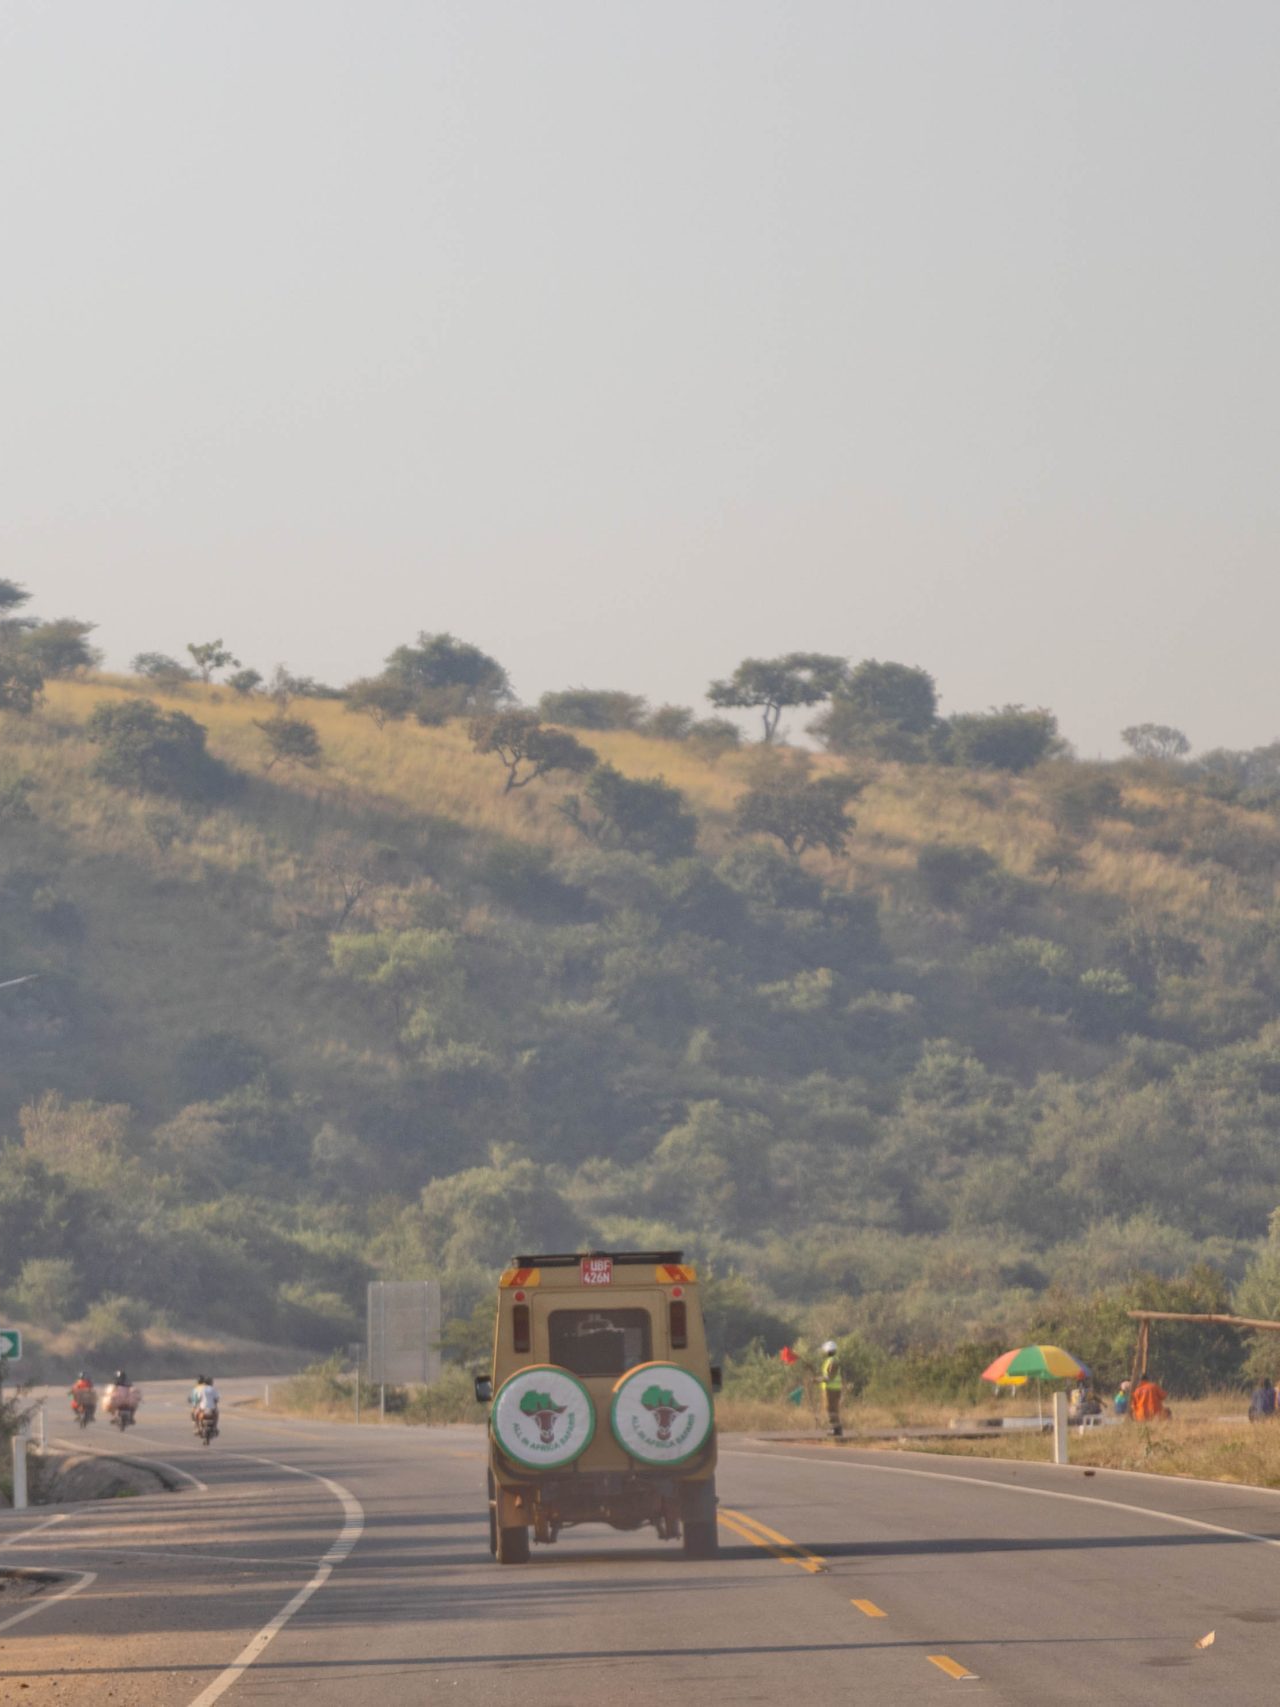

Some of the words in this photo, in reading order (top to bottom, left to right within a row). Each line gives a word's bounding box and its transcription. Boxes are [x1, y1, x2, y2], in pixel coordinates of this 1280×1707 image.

[590, 1260, 610, 1272] UBF
[584, 1272, 610, 1284] 426N
[512, 1421, 522, 1439] ALL
[529, 1442, 561, 1452] AFRICA
[631, 1415, 640, 1432] ALL
[644, 1438, 677, 1449] AFRICA
